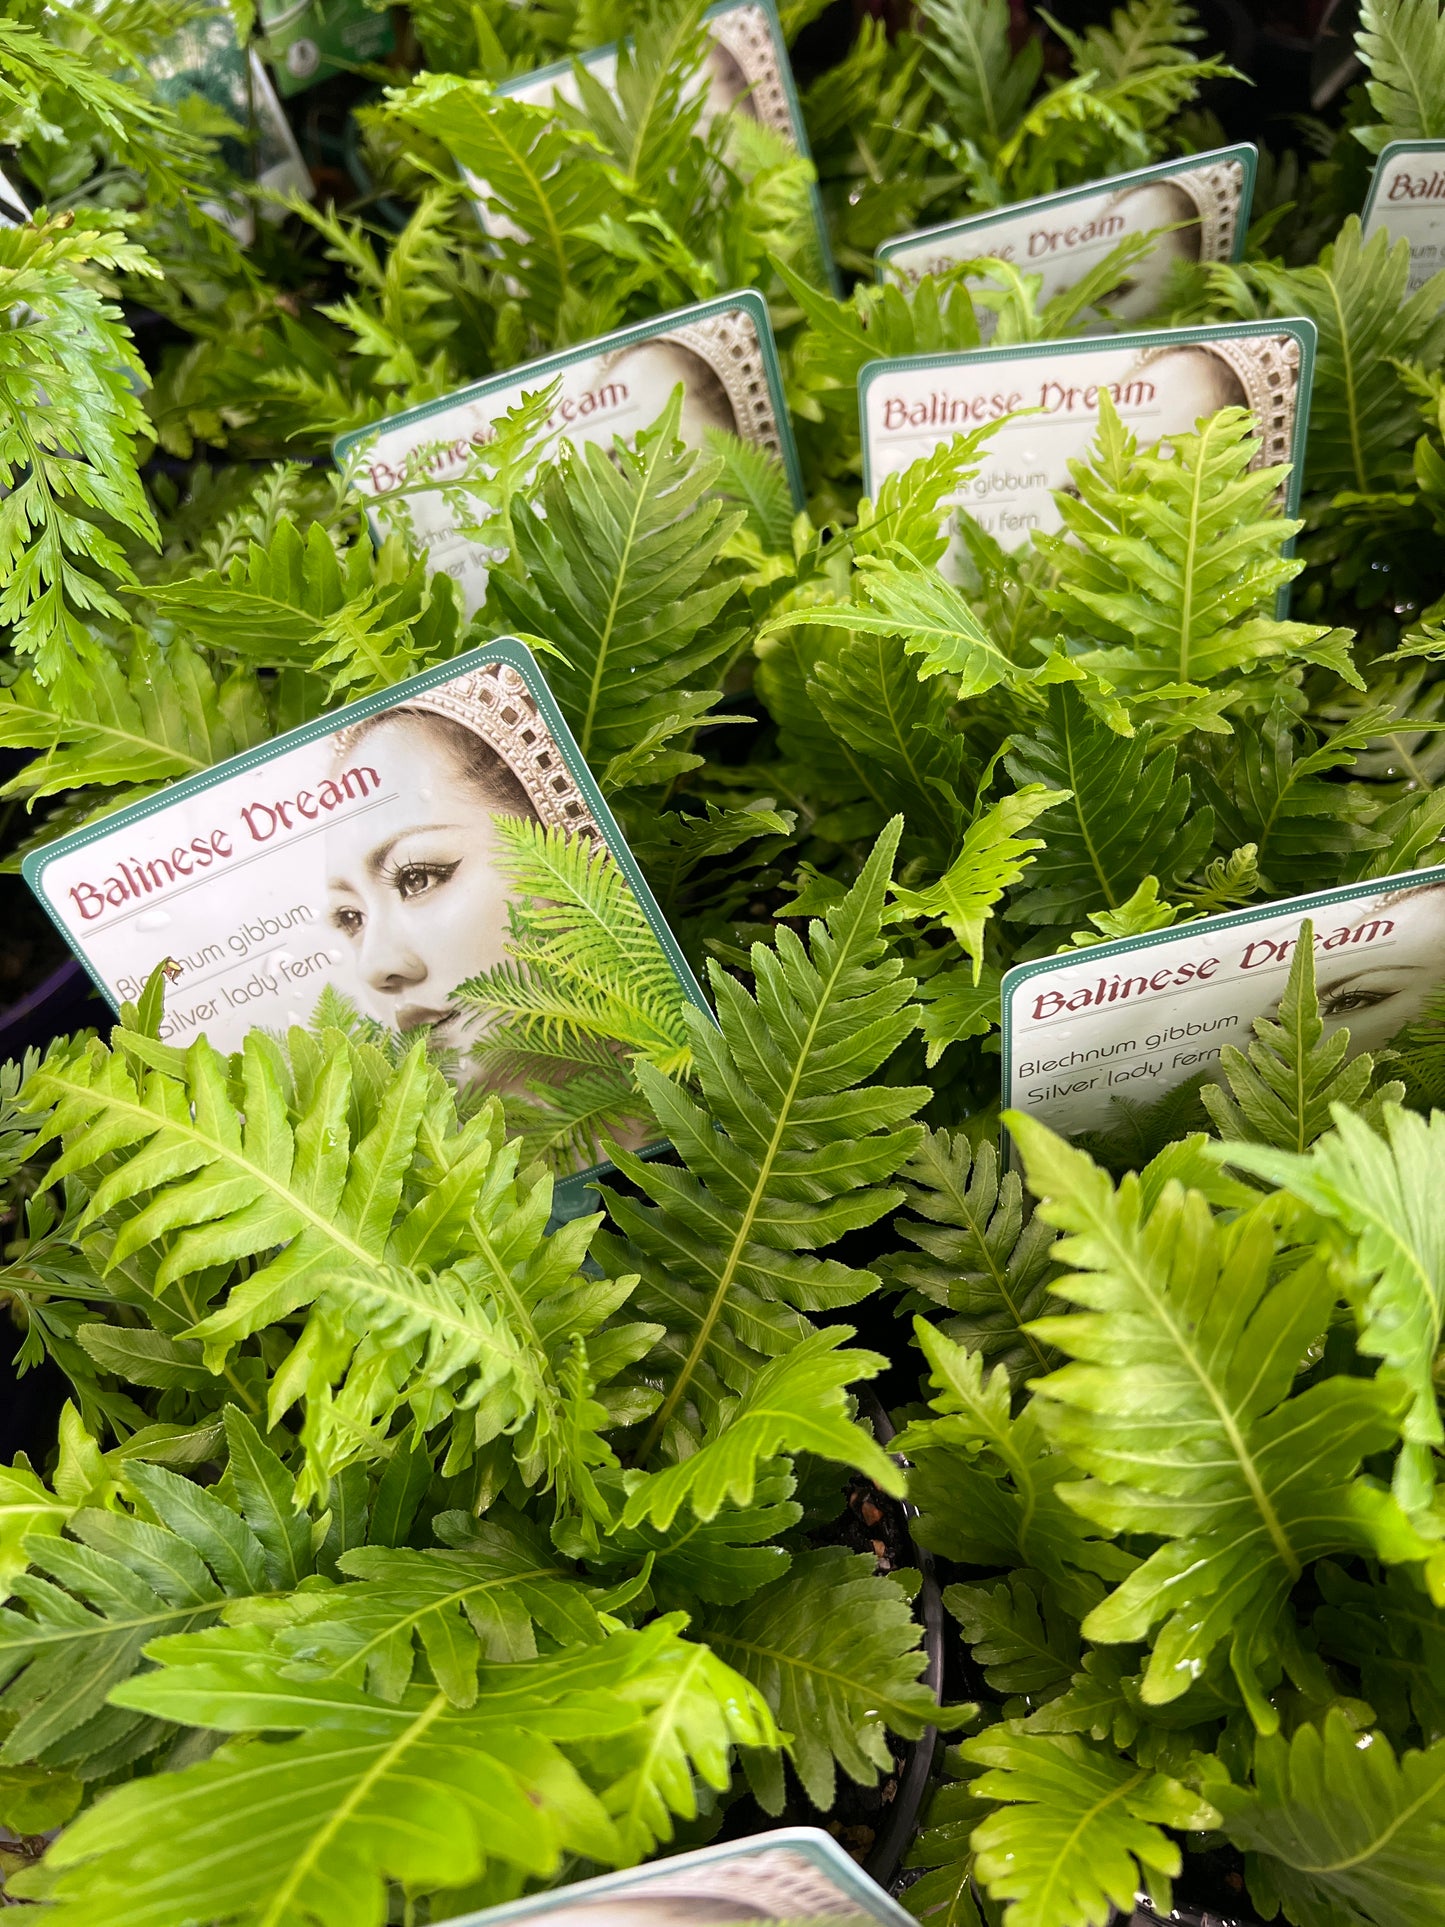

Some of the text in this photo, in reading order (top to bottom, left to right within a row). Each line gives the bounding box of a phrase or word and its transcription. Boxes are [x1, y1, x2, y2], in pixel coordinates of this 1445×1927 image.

[1387, 171, 1445, 201] Bali
[1028, 214, 1126, 258] Dream
[543, 382, 630, 429] ream
[883, 380, 1156, 430] Balinese Dream
[974, 471, 1048, 499] gibbum
[999, 510, 1039, 532] fern
[69, 766, 382, 920] Balinese Dream
[115, 903, 314, 1002] Blnum gibbum
[156, 949, 333, 1040] Silver lady fern
[1031, 956, 1220, 1021] Balinese
[1018, 1014, 1239, 1079] Blechnum gibbum
[1027, 1047, 1222, 1105] Silver lady fern
